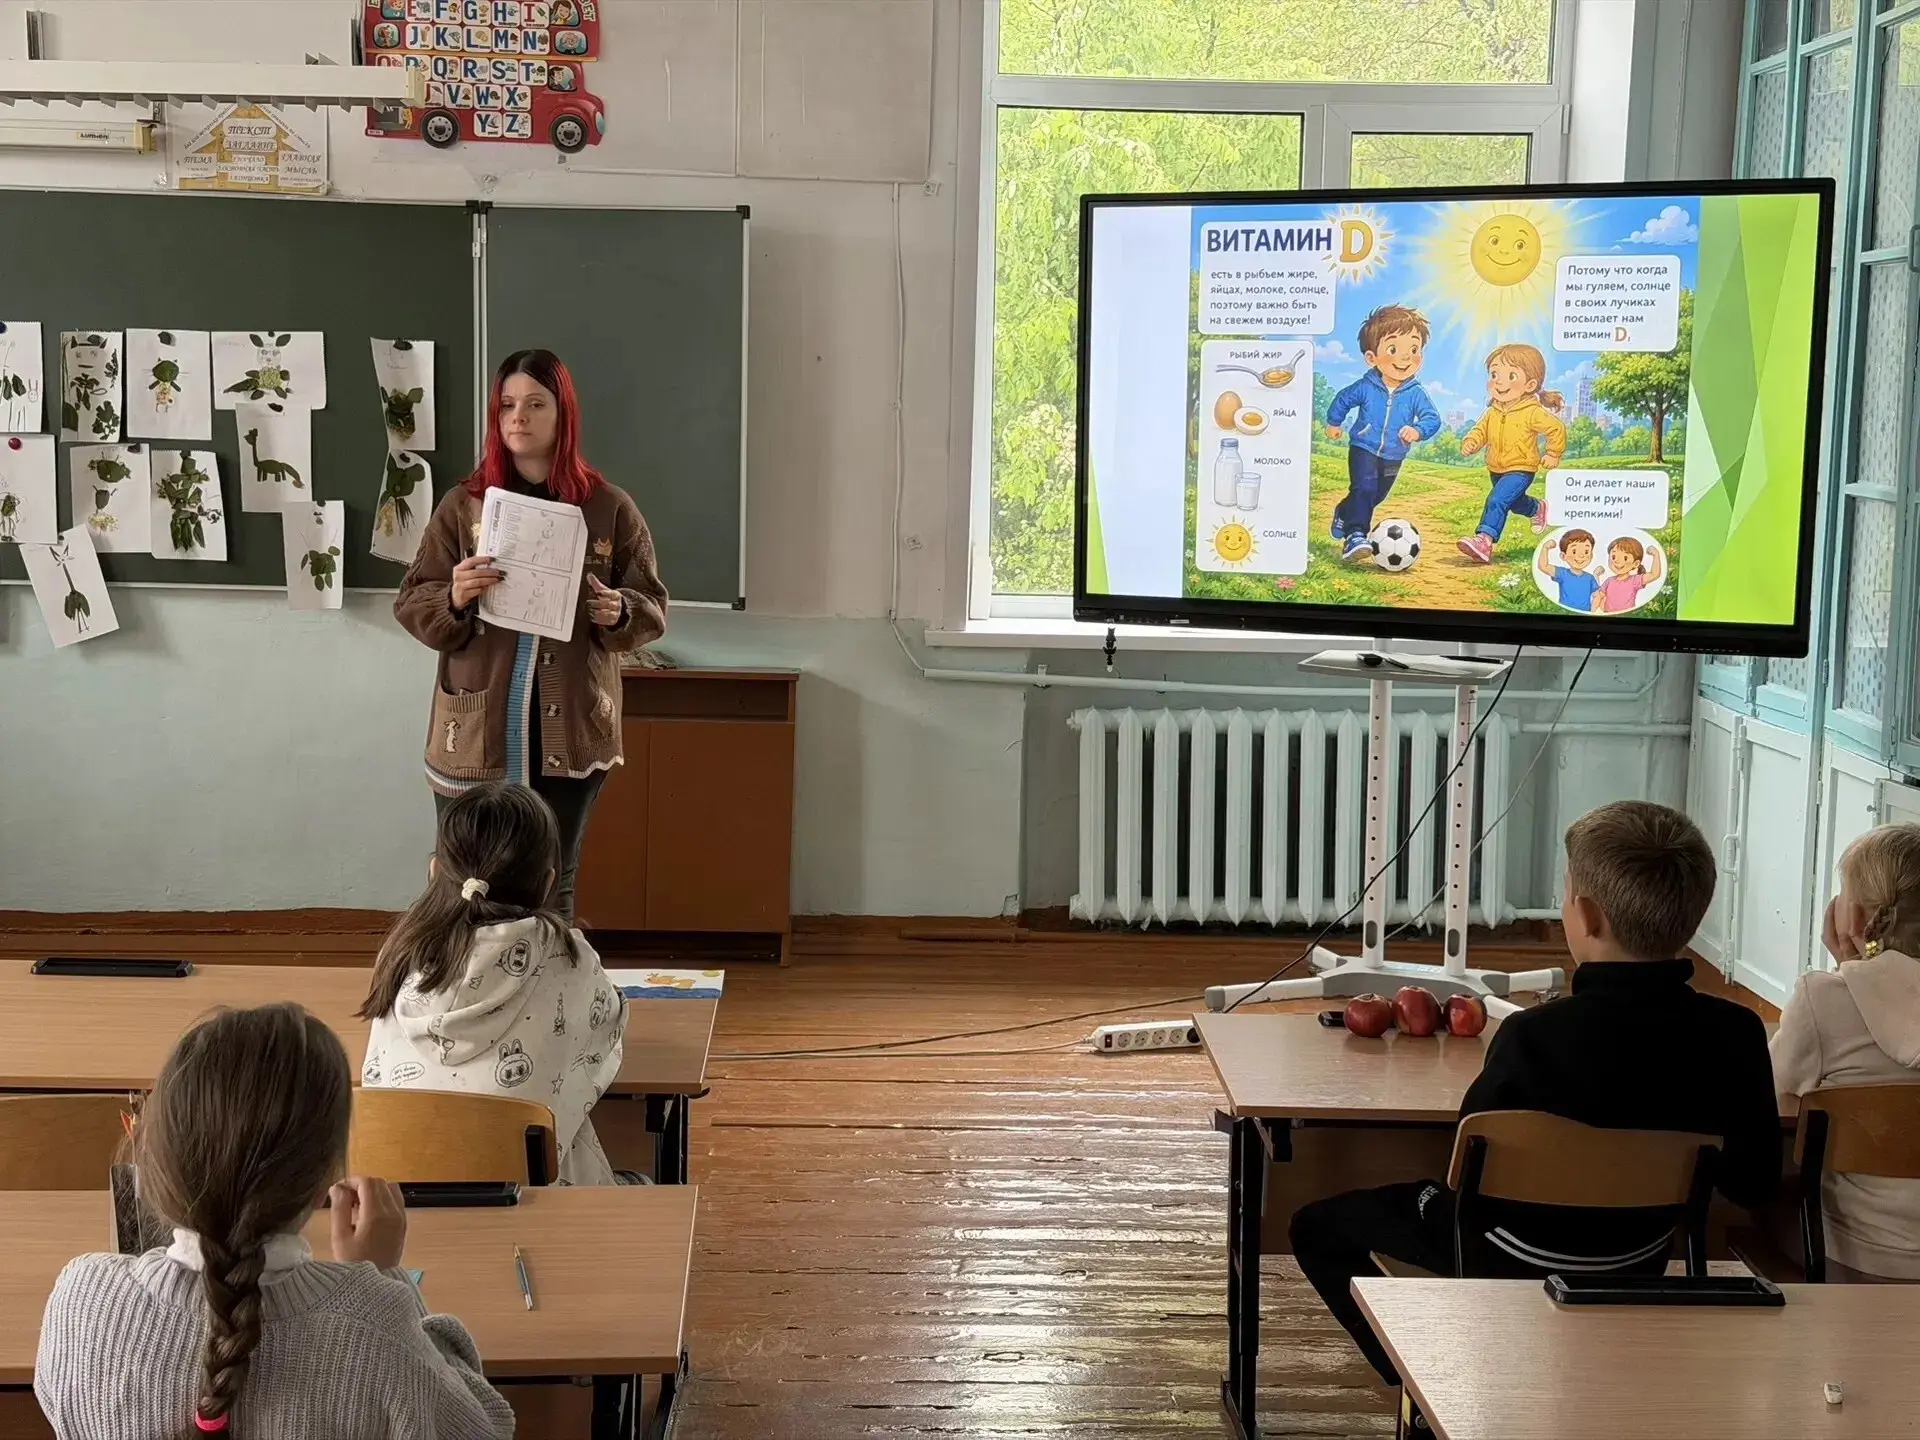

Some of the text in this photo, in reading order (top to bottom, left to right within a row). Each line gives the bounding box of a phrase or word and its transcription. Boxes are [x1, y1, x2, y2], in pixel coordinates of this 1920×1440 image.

[436, 0, 448, 18] F
[464, 1, 477, 20] G
[494, 2, 506, 21] H
[524, 4, 535, 22] I
[410, 26, 536, 50] J K L M N
[433, 57, 448, 79] Q
[464, 59, 477, 78] R
[492, 60, 506, 79] S
[521, 63, 534, 81] T
[447, 84, 460, 104] V
[475, 86, 490, 105] W
[505, 87, 518, 106] X
[476, 114, 519, 133] Y Z
[228, 125, 272, 136] ТЕКСТ
[184, 156, 212, 164] ТЕМА
[285, 166, 317, 175] МЫСЛЬ
[1207, 219, 1373, 263] ВИТАМИН D
[1211, 271, 1232, 279] есть
[1236, 271, 1241, 279] в
[1287, 271, 1318, 280] жире,
[1568, 265, 1668, 278] Потому что когда
[1210, 285, 1329, 295] яйцах, молоке, солнце,
[1586, 283, 1628, 294] гуляем,
[1631, 282, 1671, 292] солнце
[1210, 298, 1317, 312] поэтому важно быть
[1574, 299, 1607, 307] своих
[1610, 299, 1656, 309] лучиках
[1210, 315, 1311, 327] на свежем воздухе!
[1564, 315, 1644, 323] посылает нам
[1563, 331, 1611, 339] витамин
[1230, 349, 1282, 359] РЫБИЙ ЖИР
[1273, 408, 1297, 418] ЯЙЦА
[1254, 457, 1291, 466] МОЛОКО
[1565, 477, 1655, 488] Он делает наши
[1565, 495, 1630, 505] ноги и руки
[1564, 509, 1623, 519] крепкими!
[1263, 530, 1297, 539] СОЛНЦЕ
